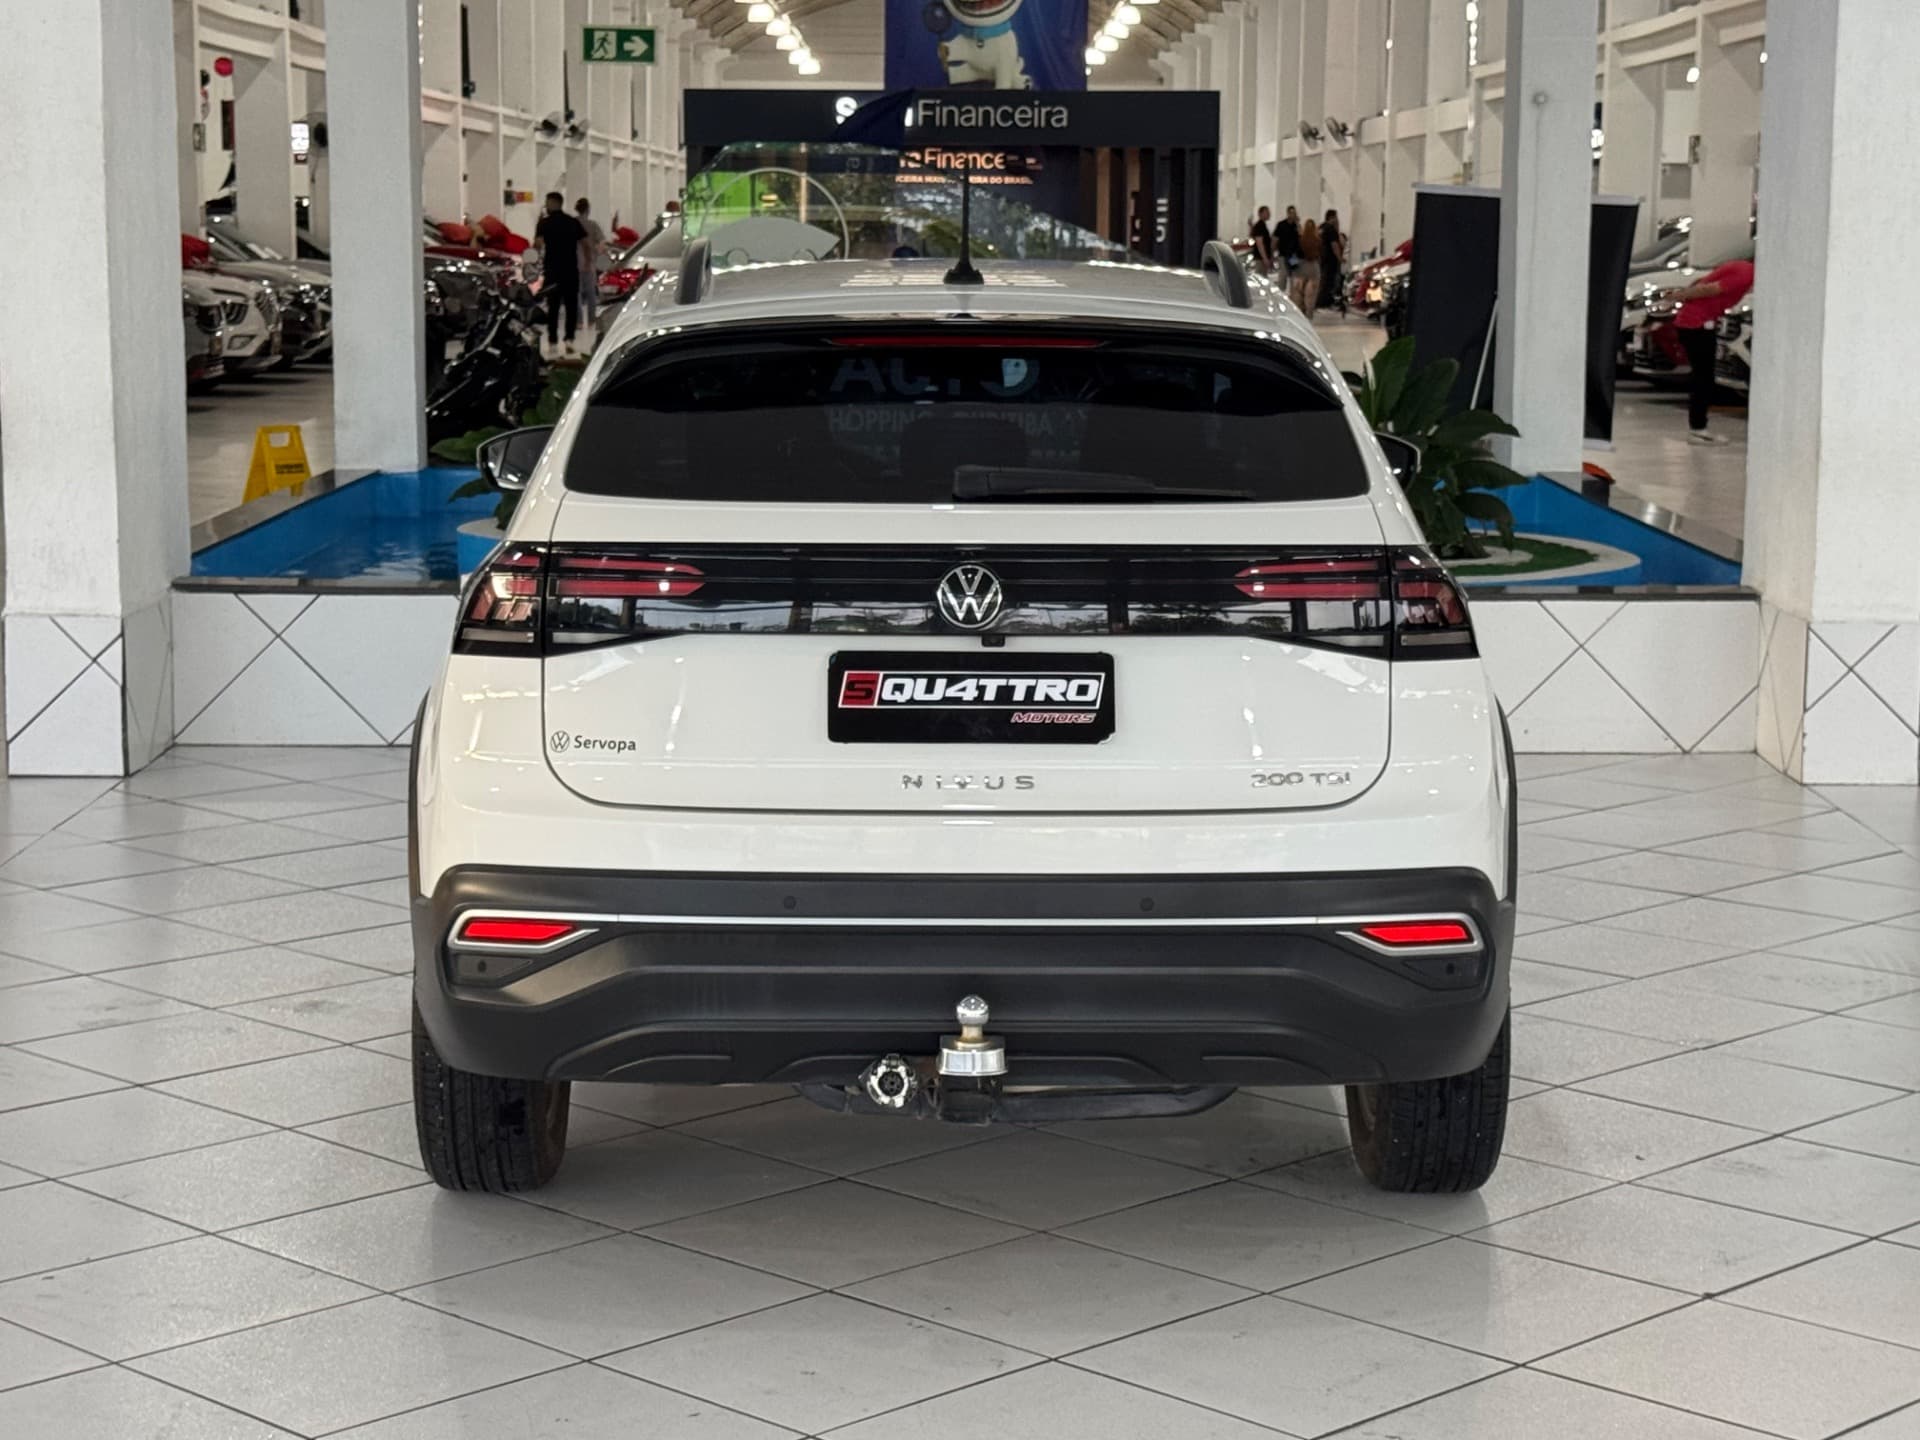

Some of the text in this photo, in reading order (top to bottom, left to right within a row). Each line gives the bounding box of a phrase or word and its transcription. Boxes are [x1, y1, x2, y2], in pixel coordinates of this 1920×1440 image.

[918, 98, 1068, 128] Financeira
[924, 147, 1025, 170] Finance
[1010, 711, 1098, 725] MOTORS
[573, 735, 637, 754] Servopa
[1250, 772, 1304, 788] 200
